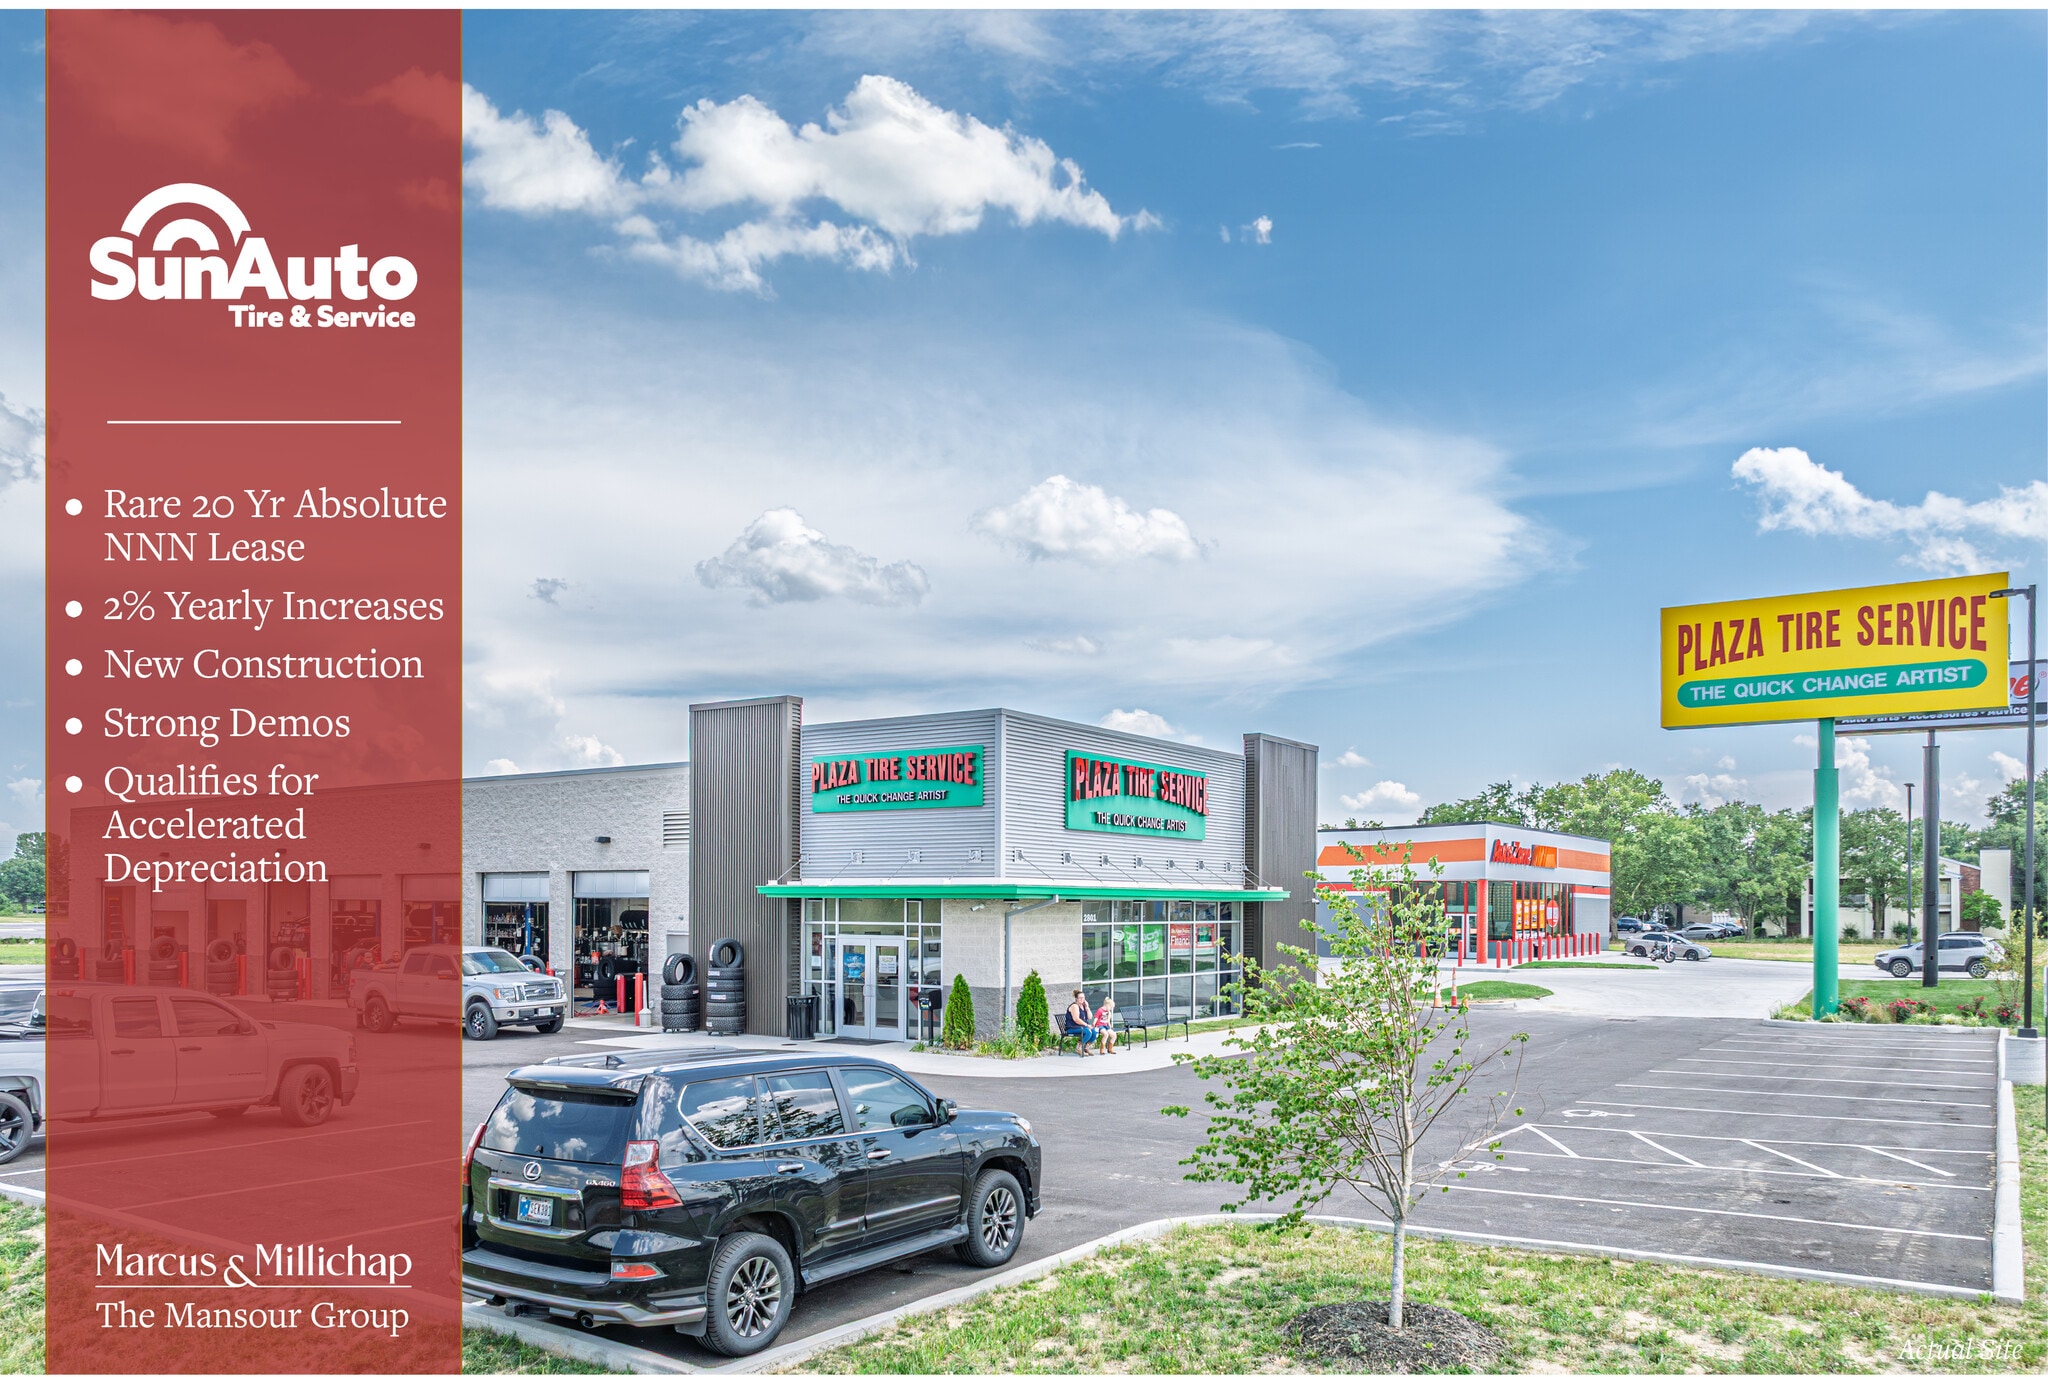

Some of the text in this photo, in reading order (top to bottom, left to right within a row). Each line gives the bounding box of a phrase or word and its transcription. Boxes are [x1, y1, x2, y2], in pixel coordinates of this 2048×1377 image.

[1677, 595, 1987, 676] PLAZA TIRE SERVICE
[1690, 666, 1973, 701] THE QUICK CHANGE ARTIST
[811, 752, 976, 793] PLAZA TIRE SERVICE
[1073, 757, 1210, 816] PLAZA TIRE SERVICE
[836, 790, 947, 804] THE QUICK CHANGE ARTIST
[1097, 811, 1187, 831] THE QUICK CHANGE ARTIST
